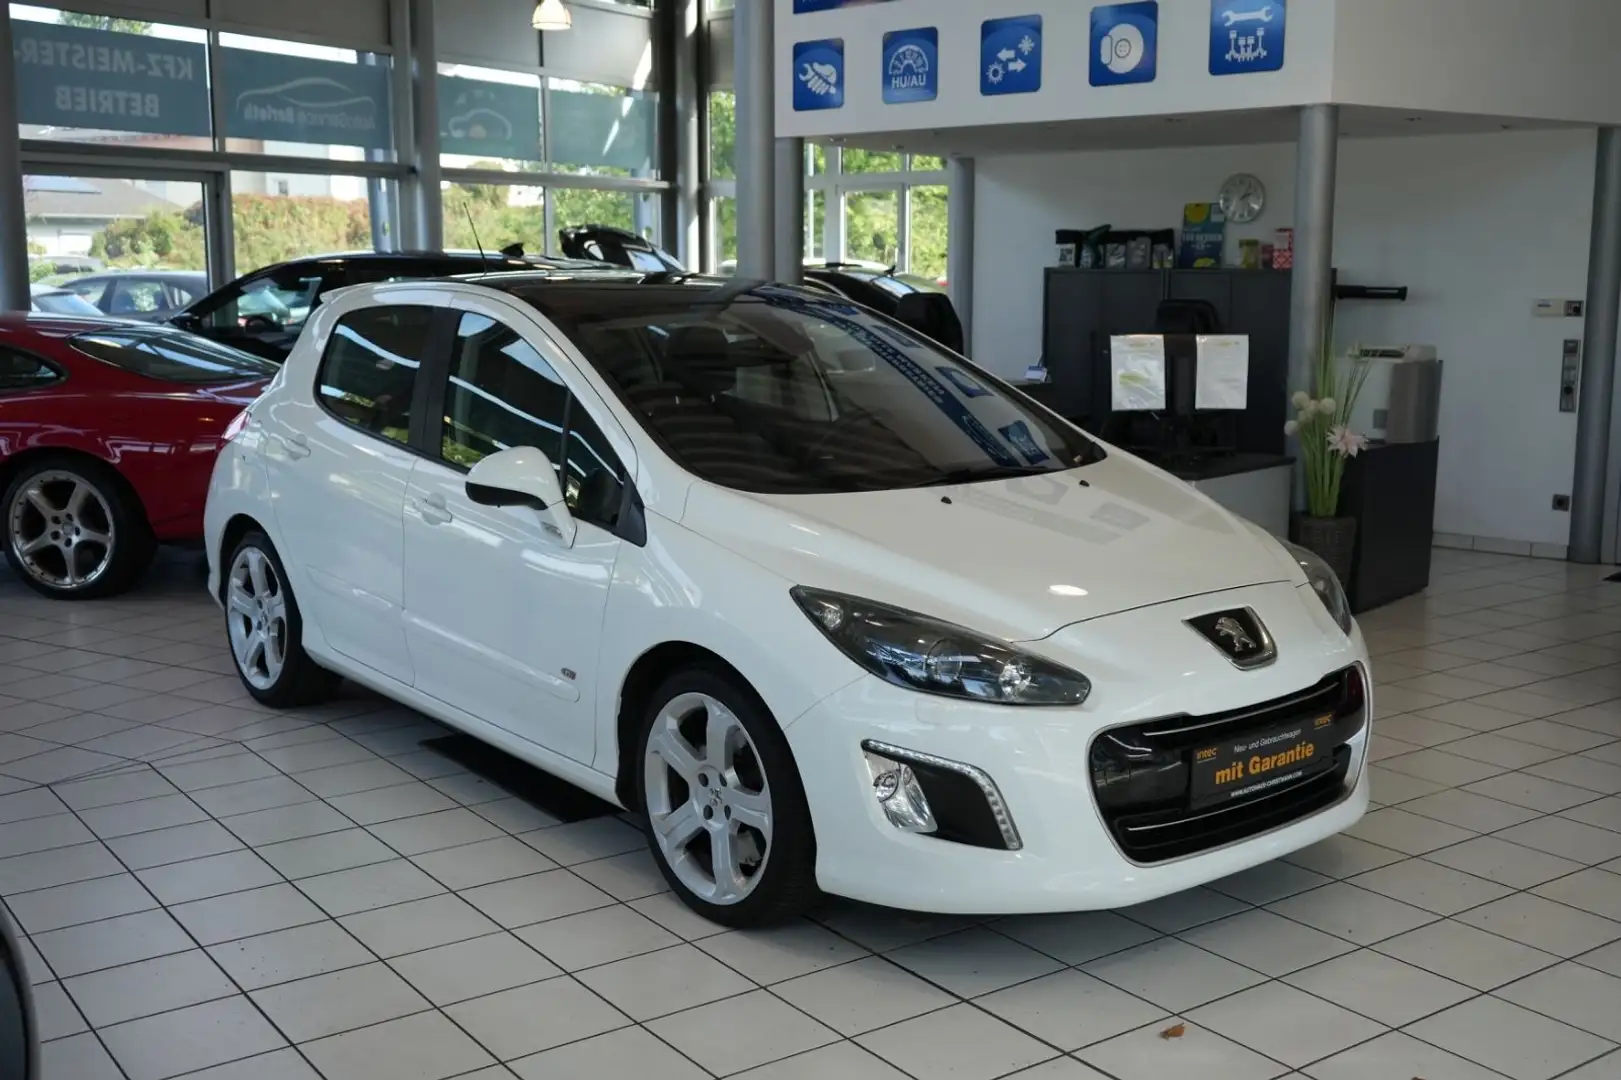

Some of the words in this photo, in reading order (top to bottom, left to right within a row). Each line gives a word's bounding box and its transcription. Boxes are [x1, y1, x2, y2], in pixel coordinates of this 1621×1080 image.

[892, 74, 926, 88] HU/AU
[1248, 739, 1259, 749] und
[1215, 761, 1244, 784] mit
[1248, 741, 1315, 774] Garantie
